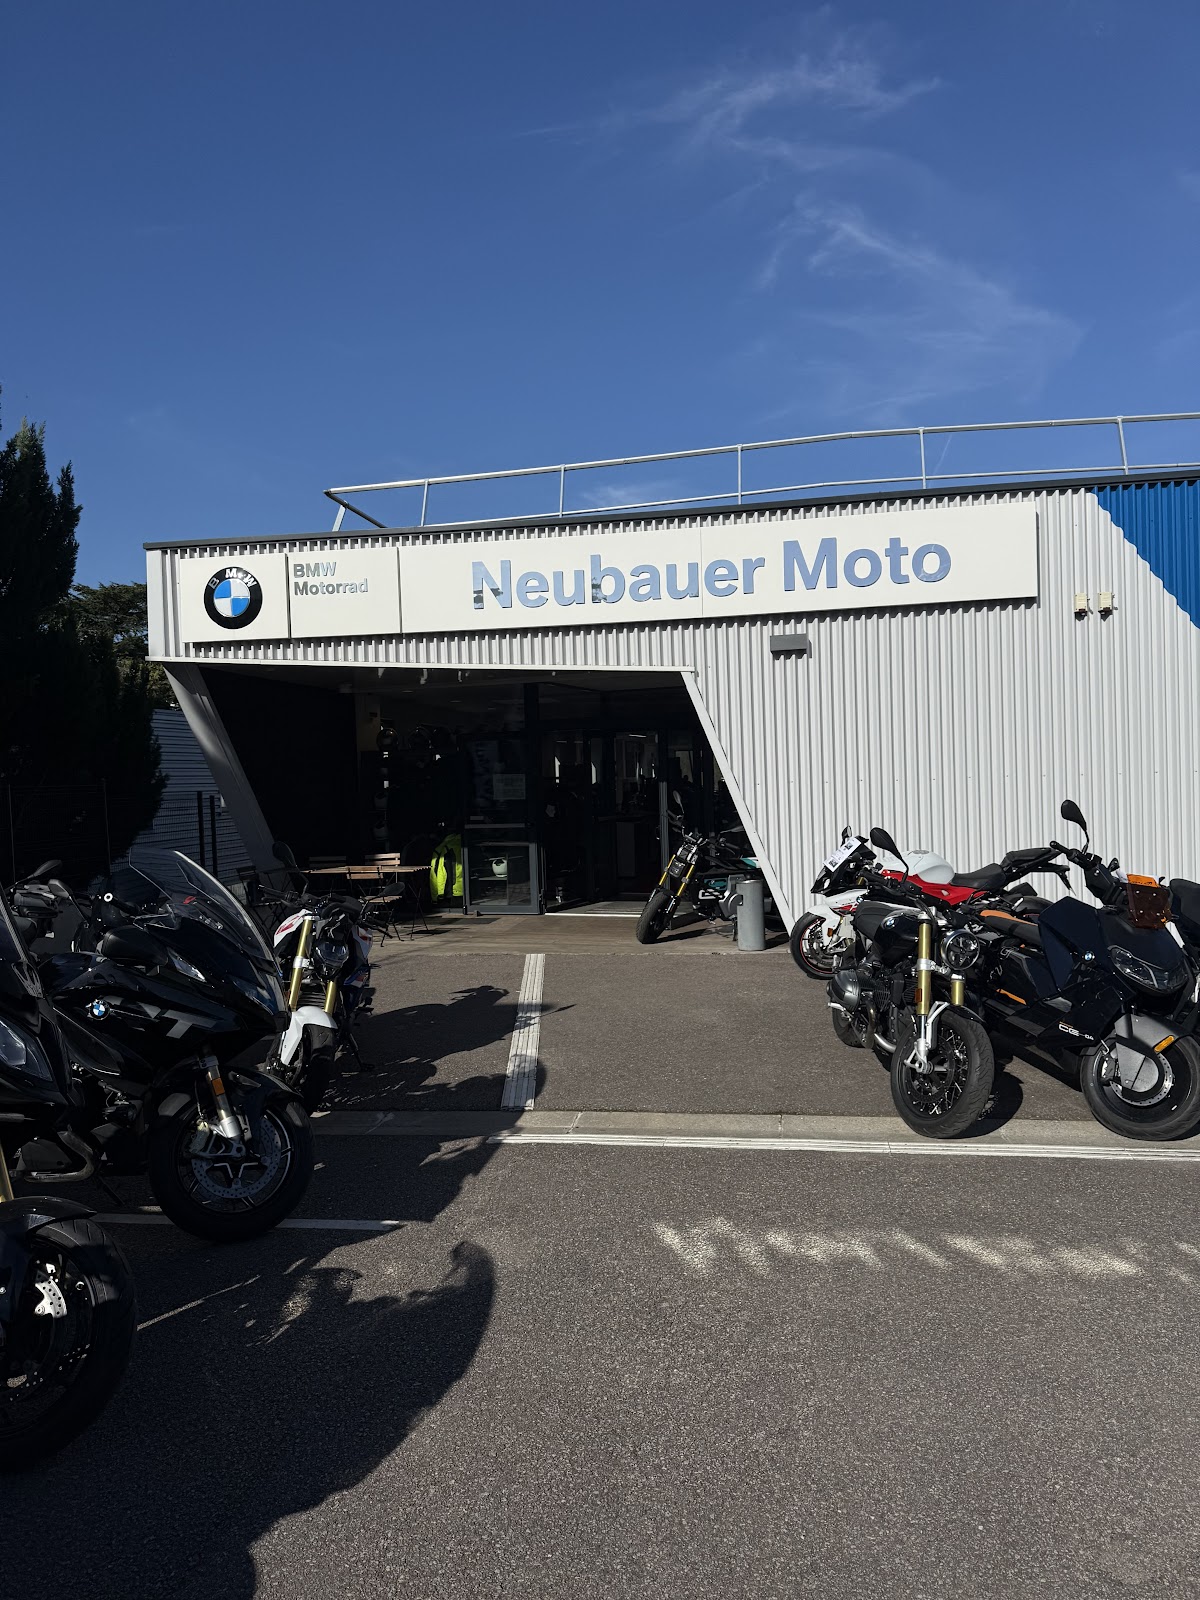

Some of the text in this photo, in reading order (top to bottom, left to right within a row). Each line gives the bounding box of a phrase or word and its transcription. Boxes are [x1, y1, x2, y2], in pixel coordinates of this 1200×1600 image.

[208, 568, 258, 589] BMW
[293, 562, 336, 578] BMW
[472, 537, 951, 609] Neubauer Moto
[294, 578, 368, 595] Motorrad
